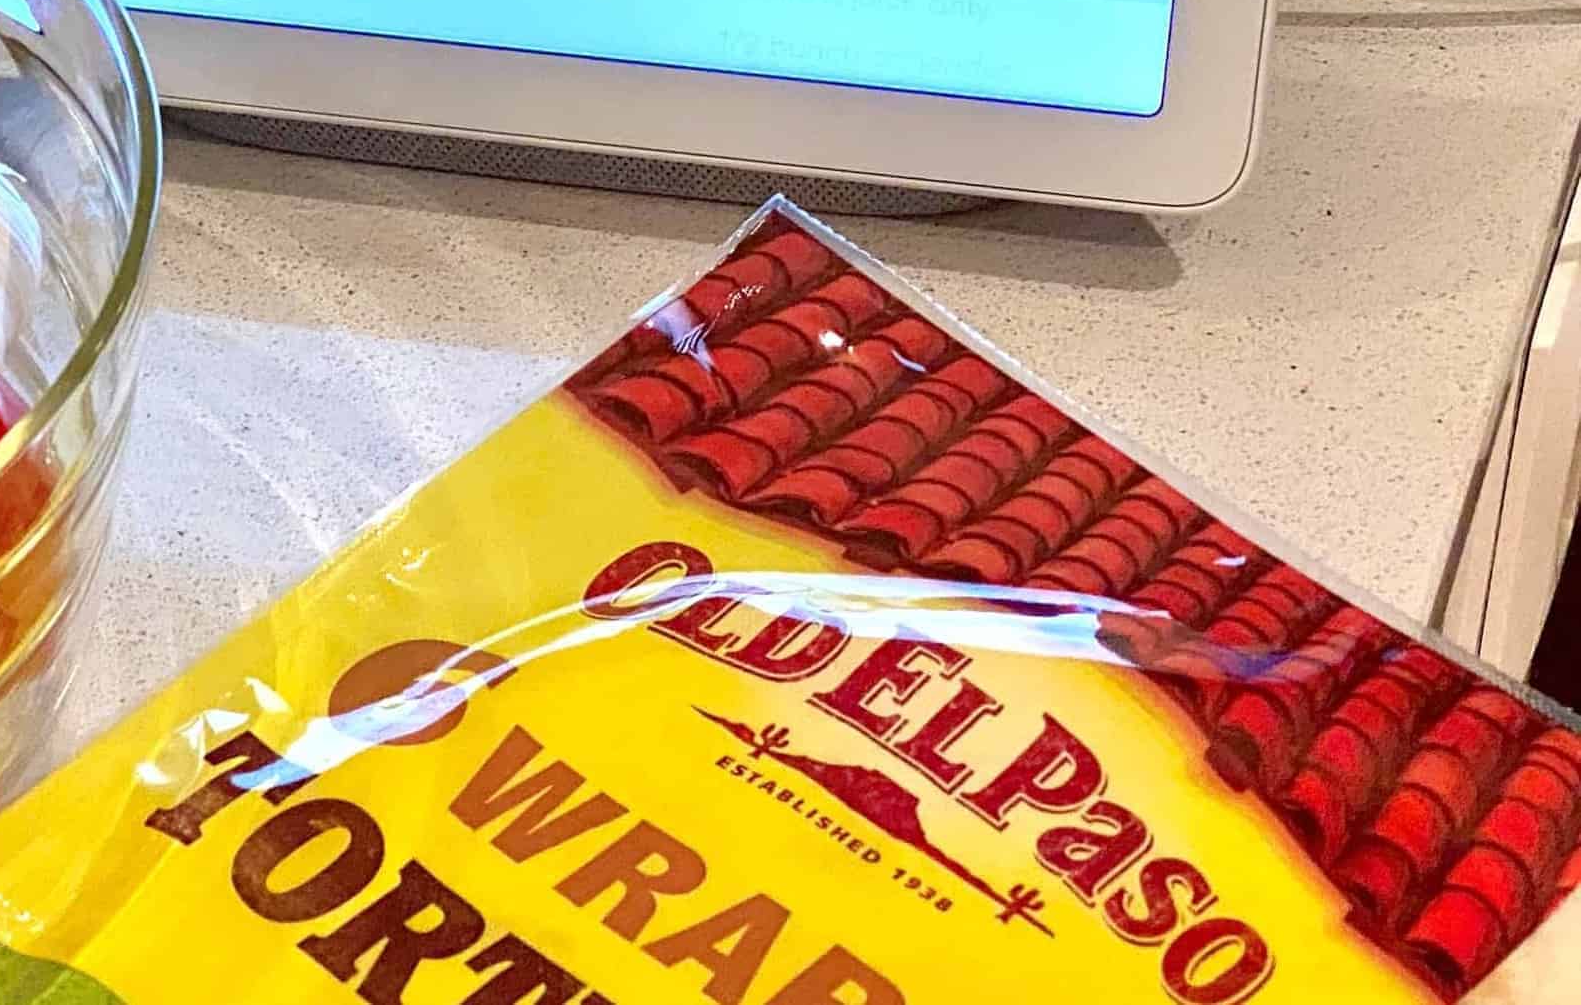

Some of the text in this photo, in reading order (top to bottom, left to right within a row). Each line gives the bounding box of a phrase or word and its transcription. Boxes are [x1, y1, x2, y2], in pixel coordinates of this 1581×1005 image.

[579, 541, 852, 682] OLD
[145, 730, 619, 1005] TORT
[715, 755, 956, 914] ESTABLISHED 1938
